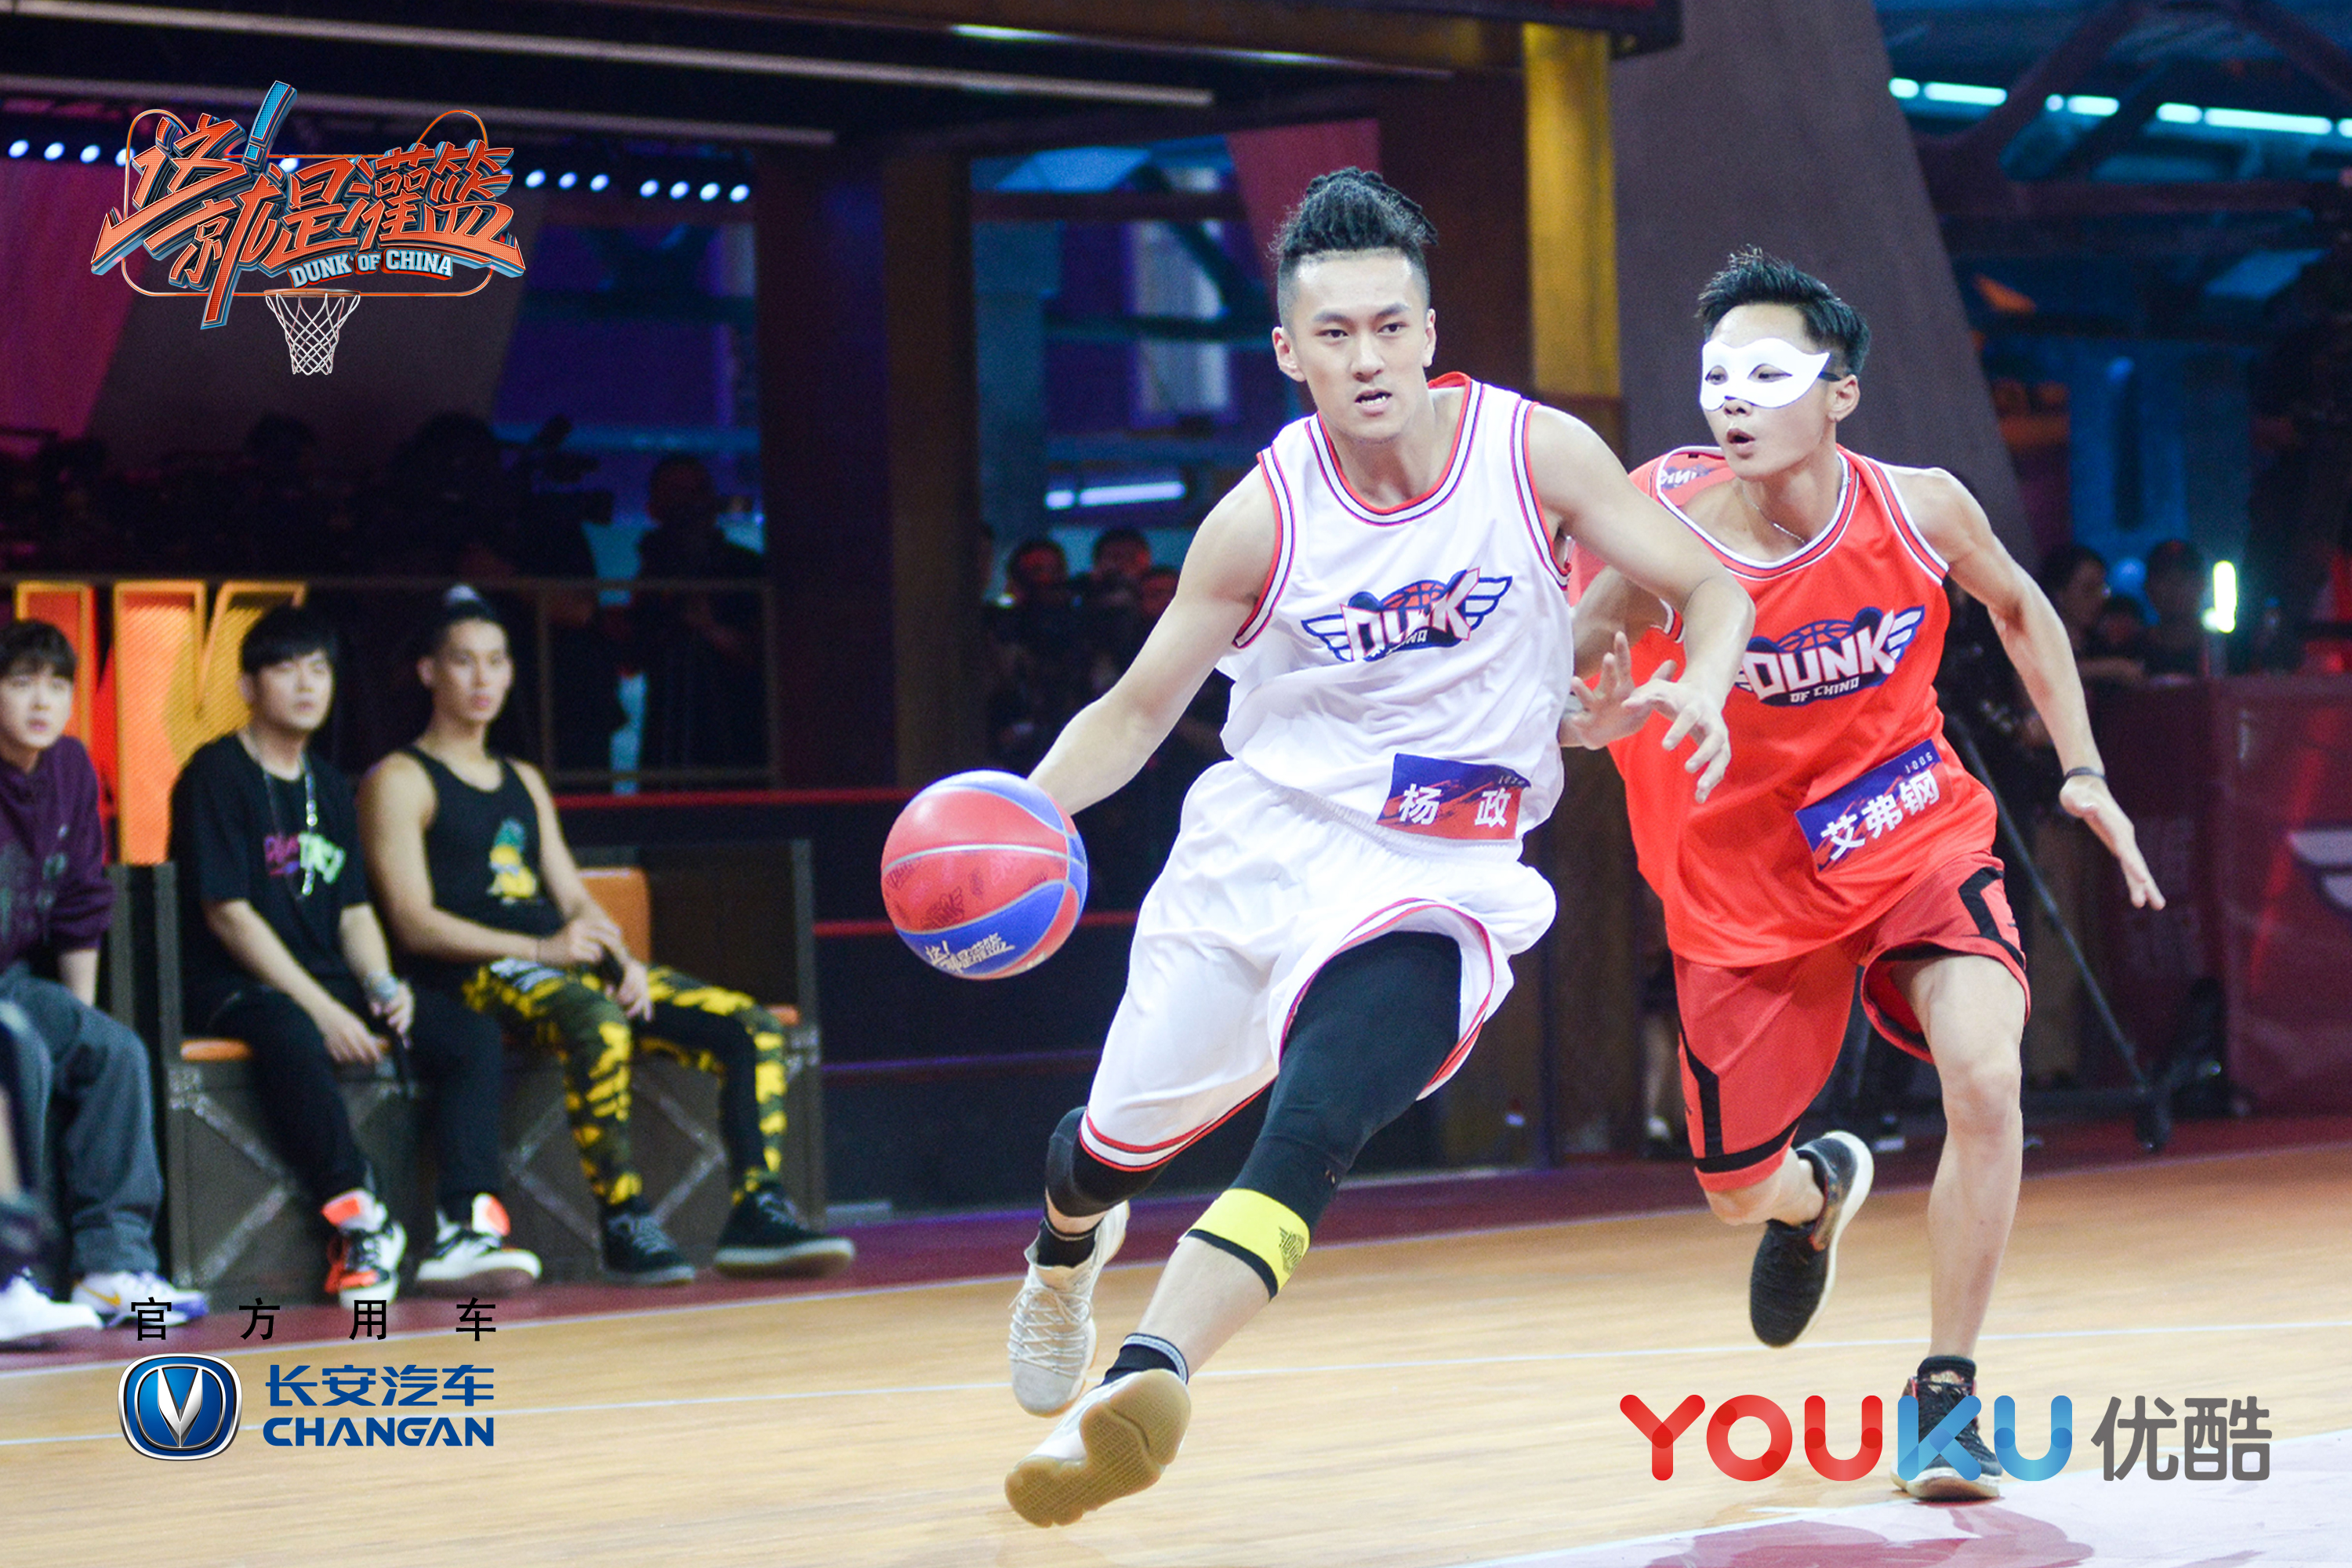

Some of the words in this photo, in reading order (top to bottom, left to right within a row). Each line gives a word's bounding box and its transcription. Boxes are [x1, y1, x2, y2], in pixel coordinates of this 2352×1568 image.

[1339, 567, 1480, 662] DUNK
[1741, 608, 1896, 701] DUNK
[1789, 690, 1810, 703] OF
[1399, 782, 1512, 828] 杨政
[1820, 769, 1940, 861] 艾弗钢
